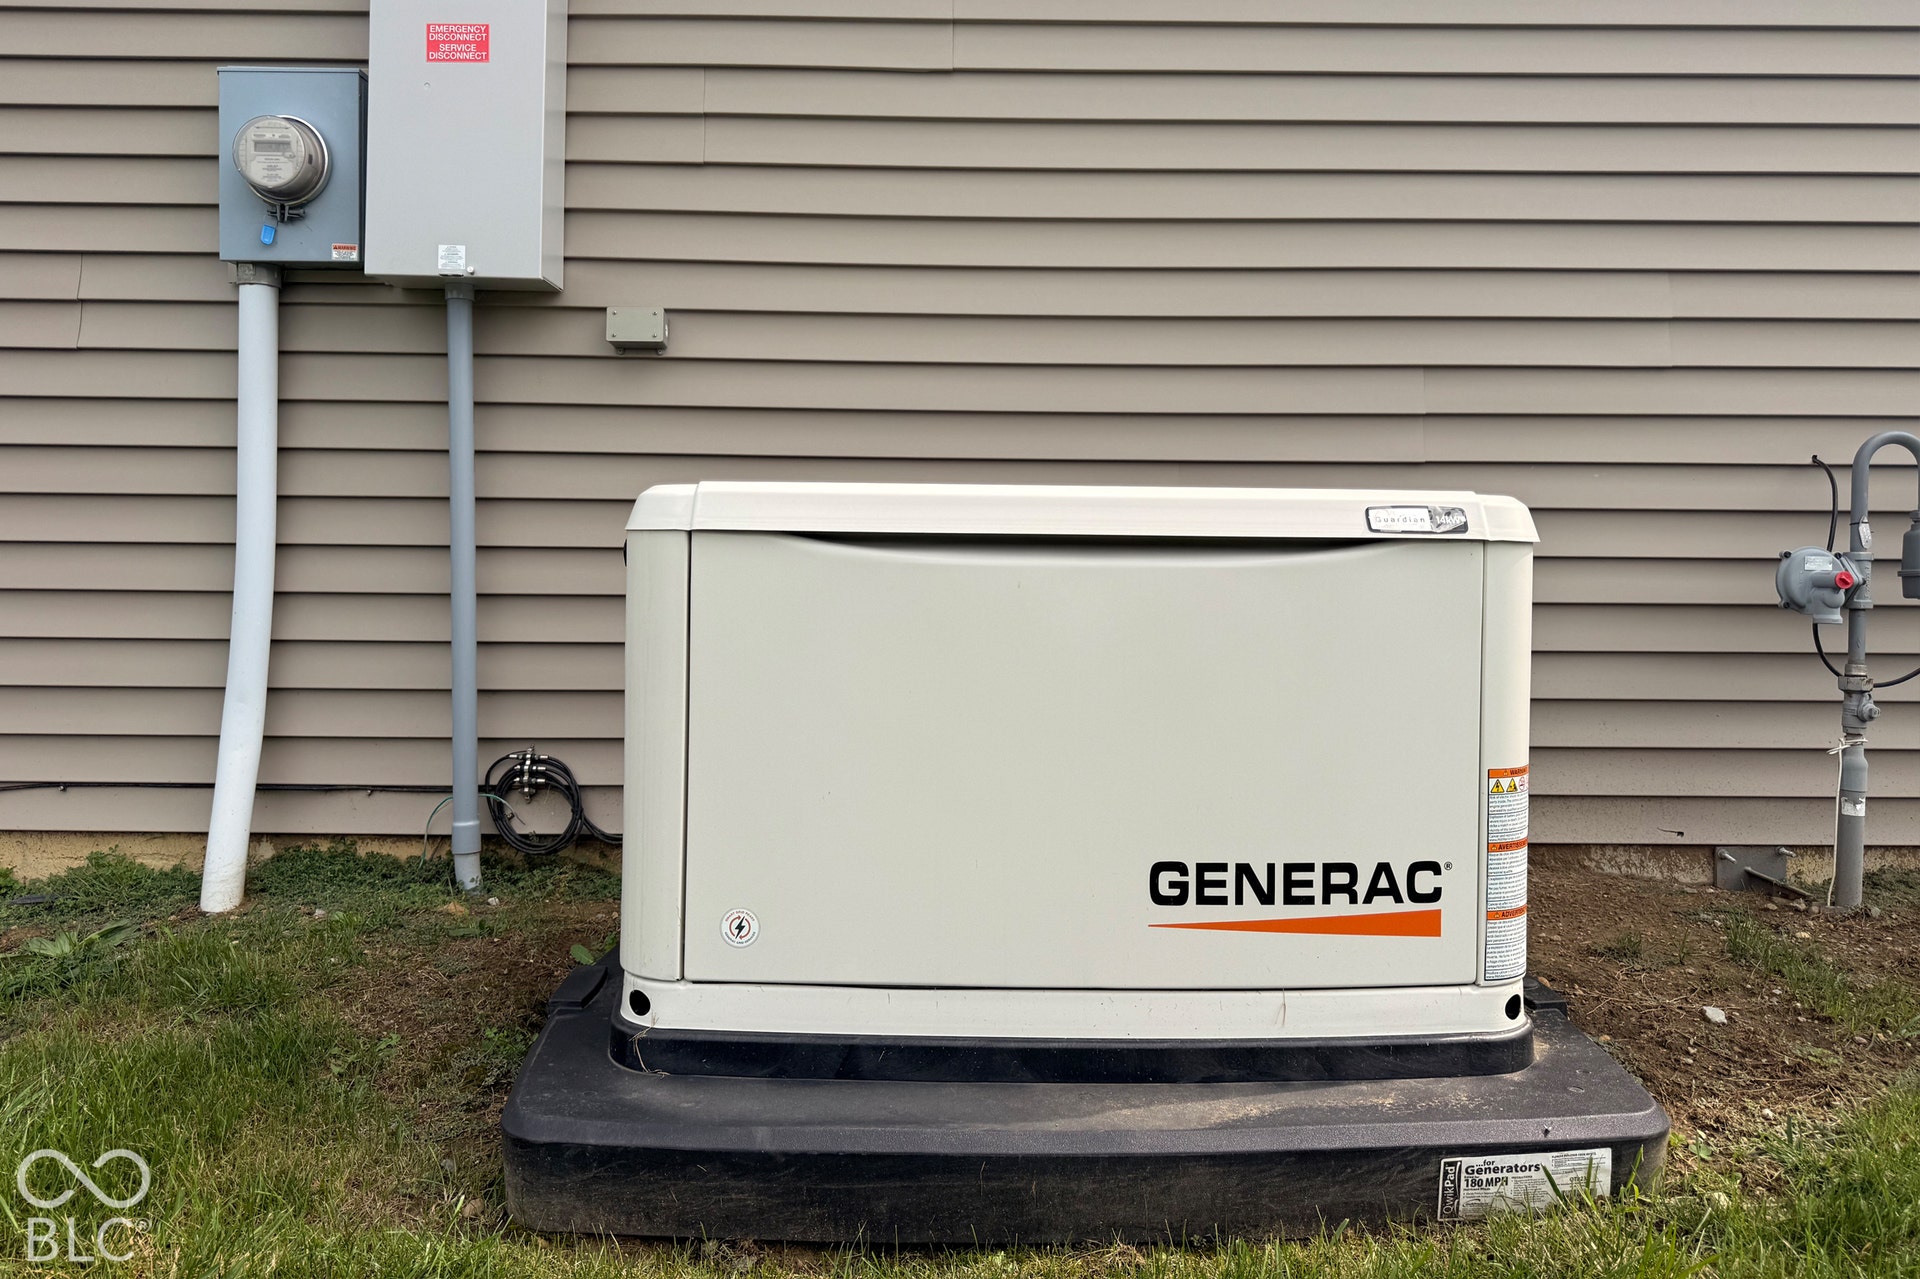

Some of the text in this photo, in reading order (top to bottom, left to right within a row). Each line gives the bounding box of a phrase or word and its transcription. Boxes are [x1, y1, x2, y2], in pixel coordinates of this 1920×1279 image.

[429, 25, 487, 33] EMERGENCY
[429, 33, 487, 41] DISCONNECT
[439, 44, 477, 52] SERVICE
[429, 51, 487, 60] DISCONNECT
[1375, 515, 1426, 524] Guardian
[1464, 1163, 1541, 1175] Generators
[1464, 1176, 1509, 1188] 180 MPH
